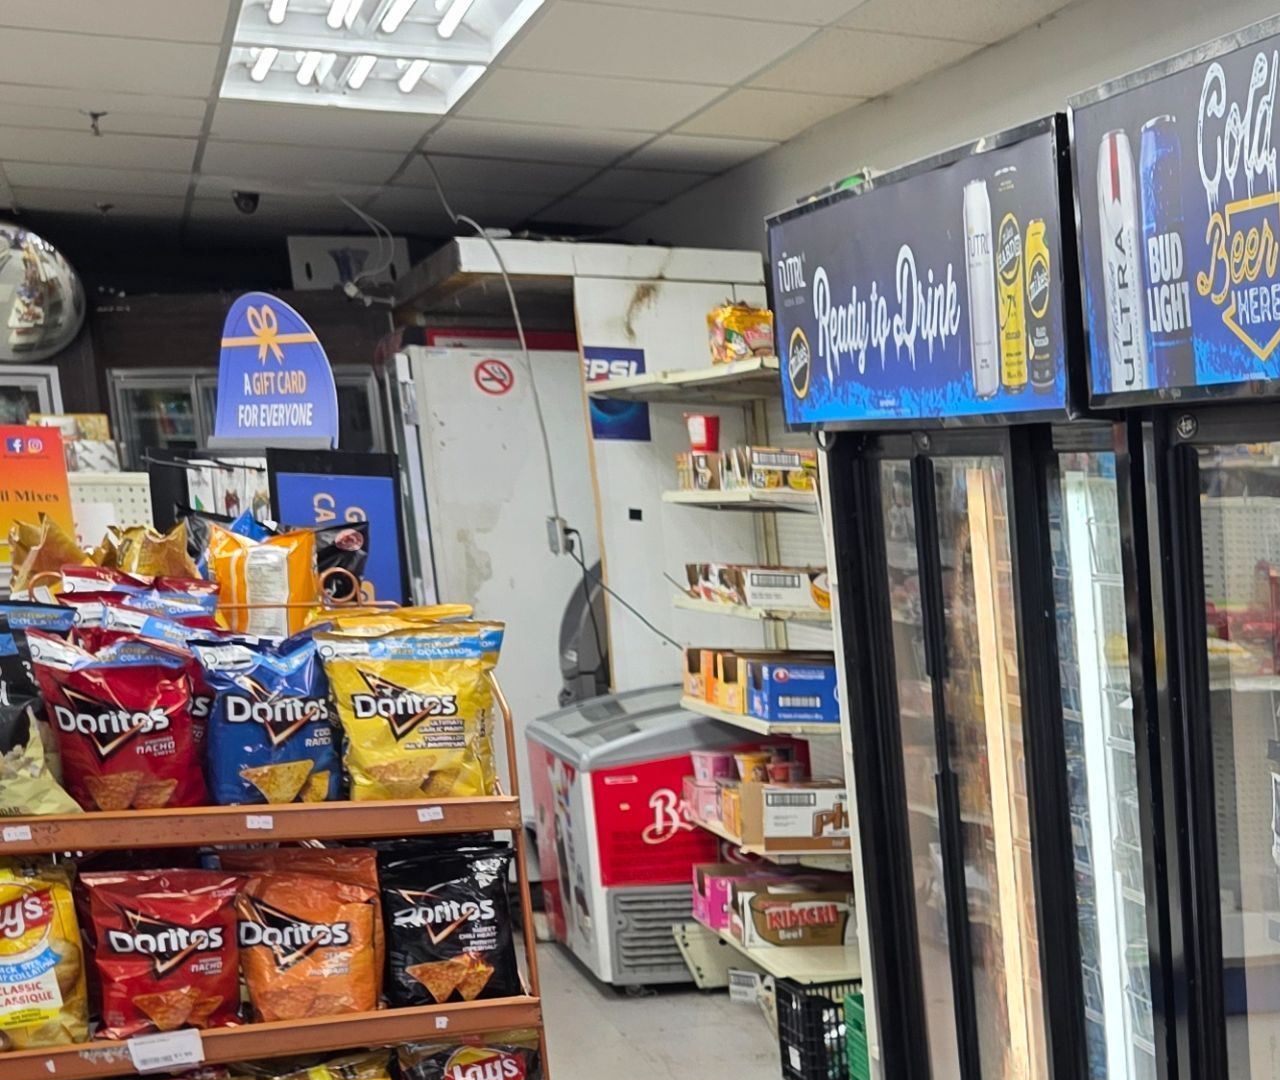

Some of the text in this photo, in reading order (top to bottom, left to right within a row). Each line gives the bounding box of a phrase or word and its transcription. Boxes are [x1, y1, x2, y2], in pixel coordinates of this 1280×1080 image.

[1198, 50, 1279, 198] Cold
[1149, 231, 1184, 284] BUD
[1197, 211, 1279, 305] Beer
[813, 244, 961, 376] Ready to Drink
[1114, 226, 1136, 386] ULTRA
[1149, 280, 1192, 333] LIGHT
[243, 370, 307, 396] A GIFT CARD
[238, 403, 314, 428] FOR EVERYONE
[54, 704, 170, 735] Doritos
[226, 695, 328, 723] Doritos
[354, 694, 458, 718] Doritos
[108, 927, 224, 954] Doritos
[239, 923, 349, 947] Doritos
